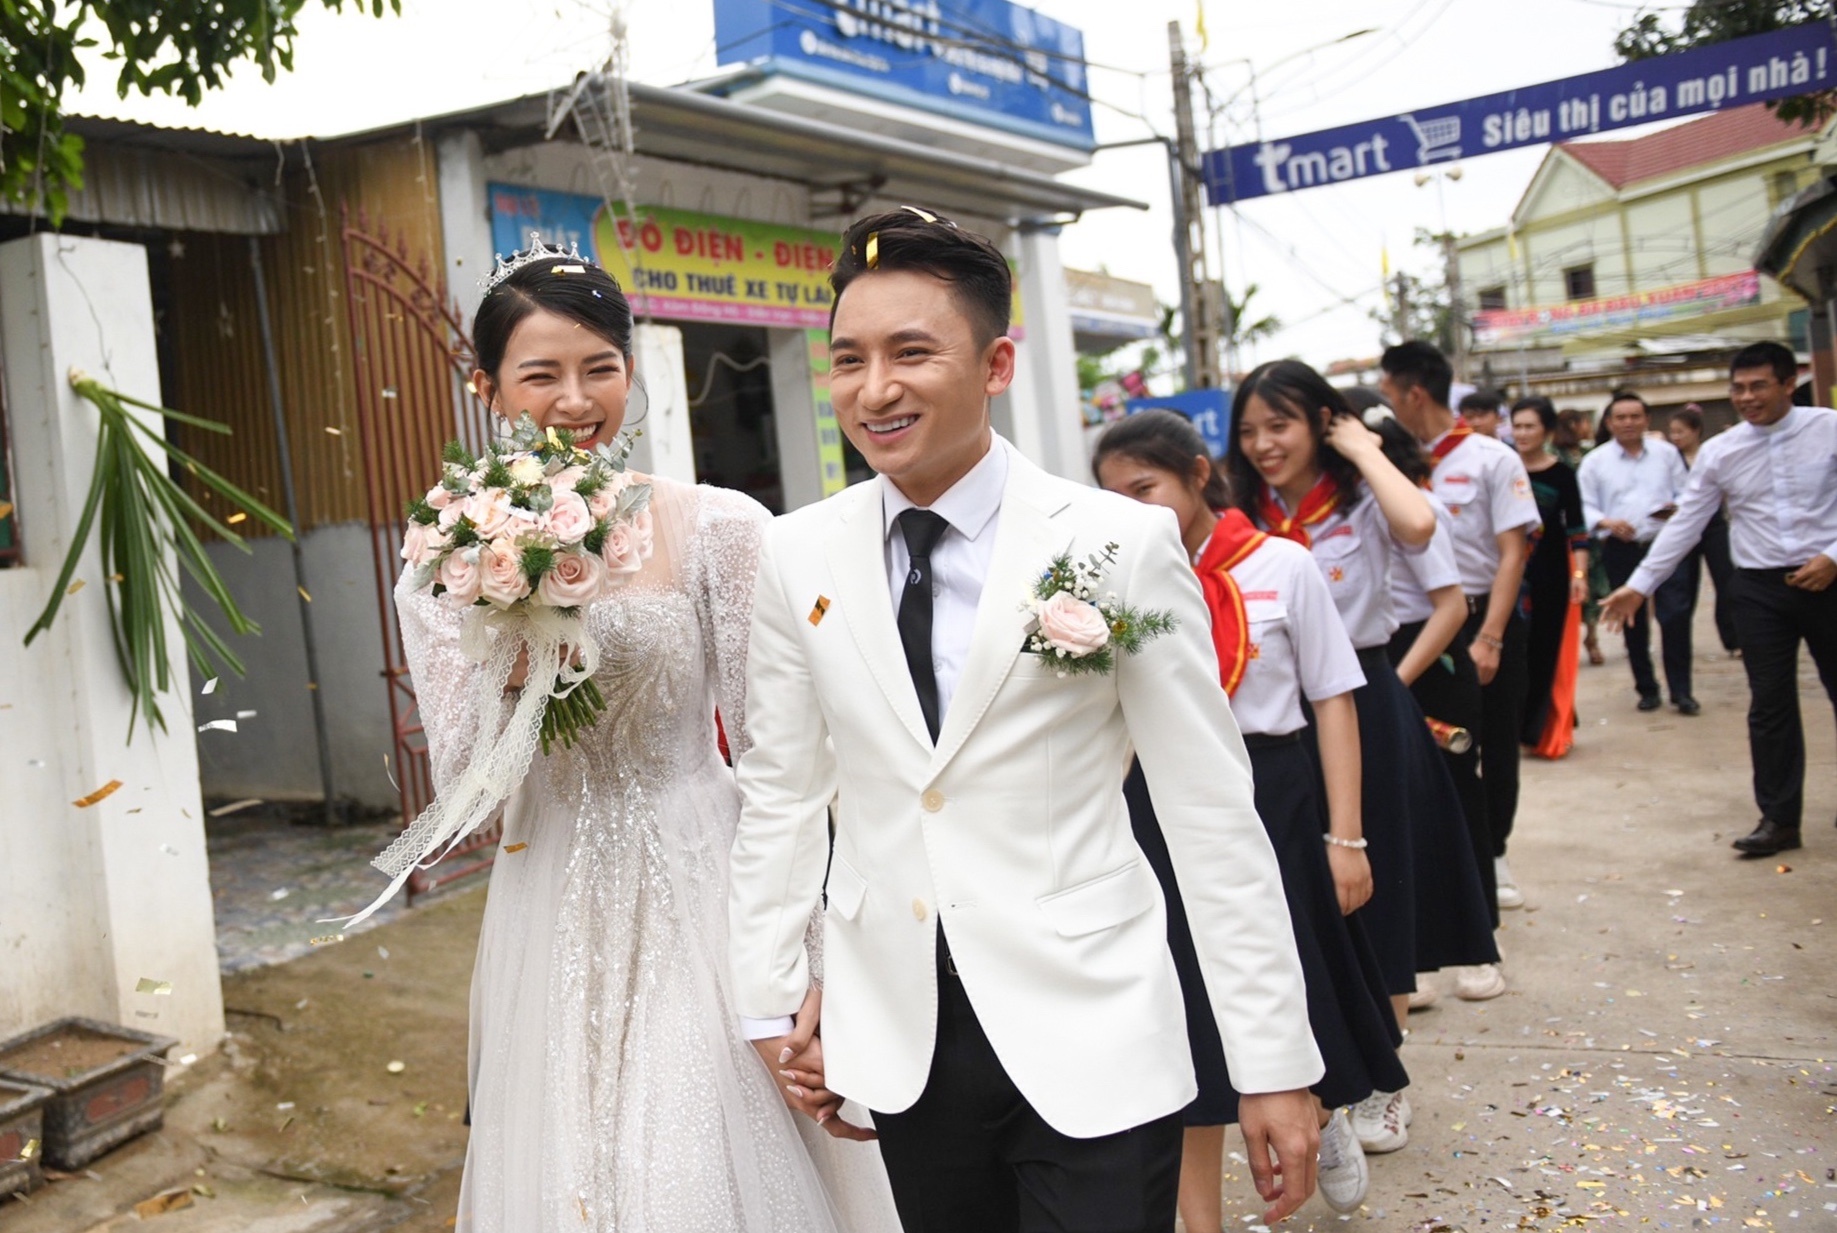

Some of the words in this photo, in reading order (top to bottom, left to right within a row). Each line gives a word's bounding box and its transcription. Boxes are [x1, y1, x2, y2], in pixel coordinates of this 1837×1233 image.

[1254, 132, 1391, 194] tmart
[1482, 107, 1550, 147] Siêu
[1558, 93, 1600, 133] thị
[1608, 81, 1667, 122] của
[1677, 65, 1738, 108] mọi
[744, 278, 769, 299] XE
